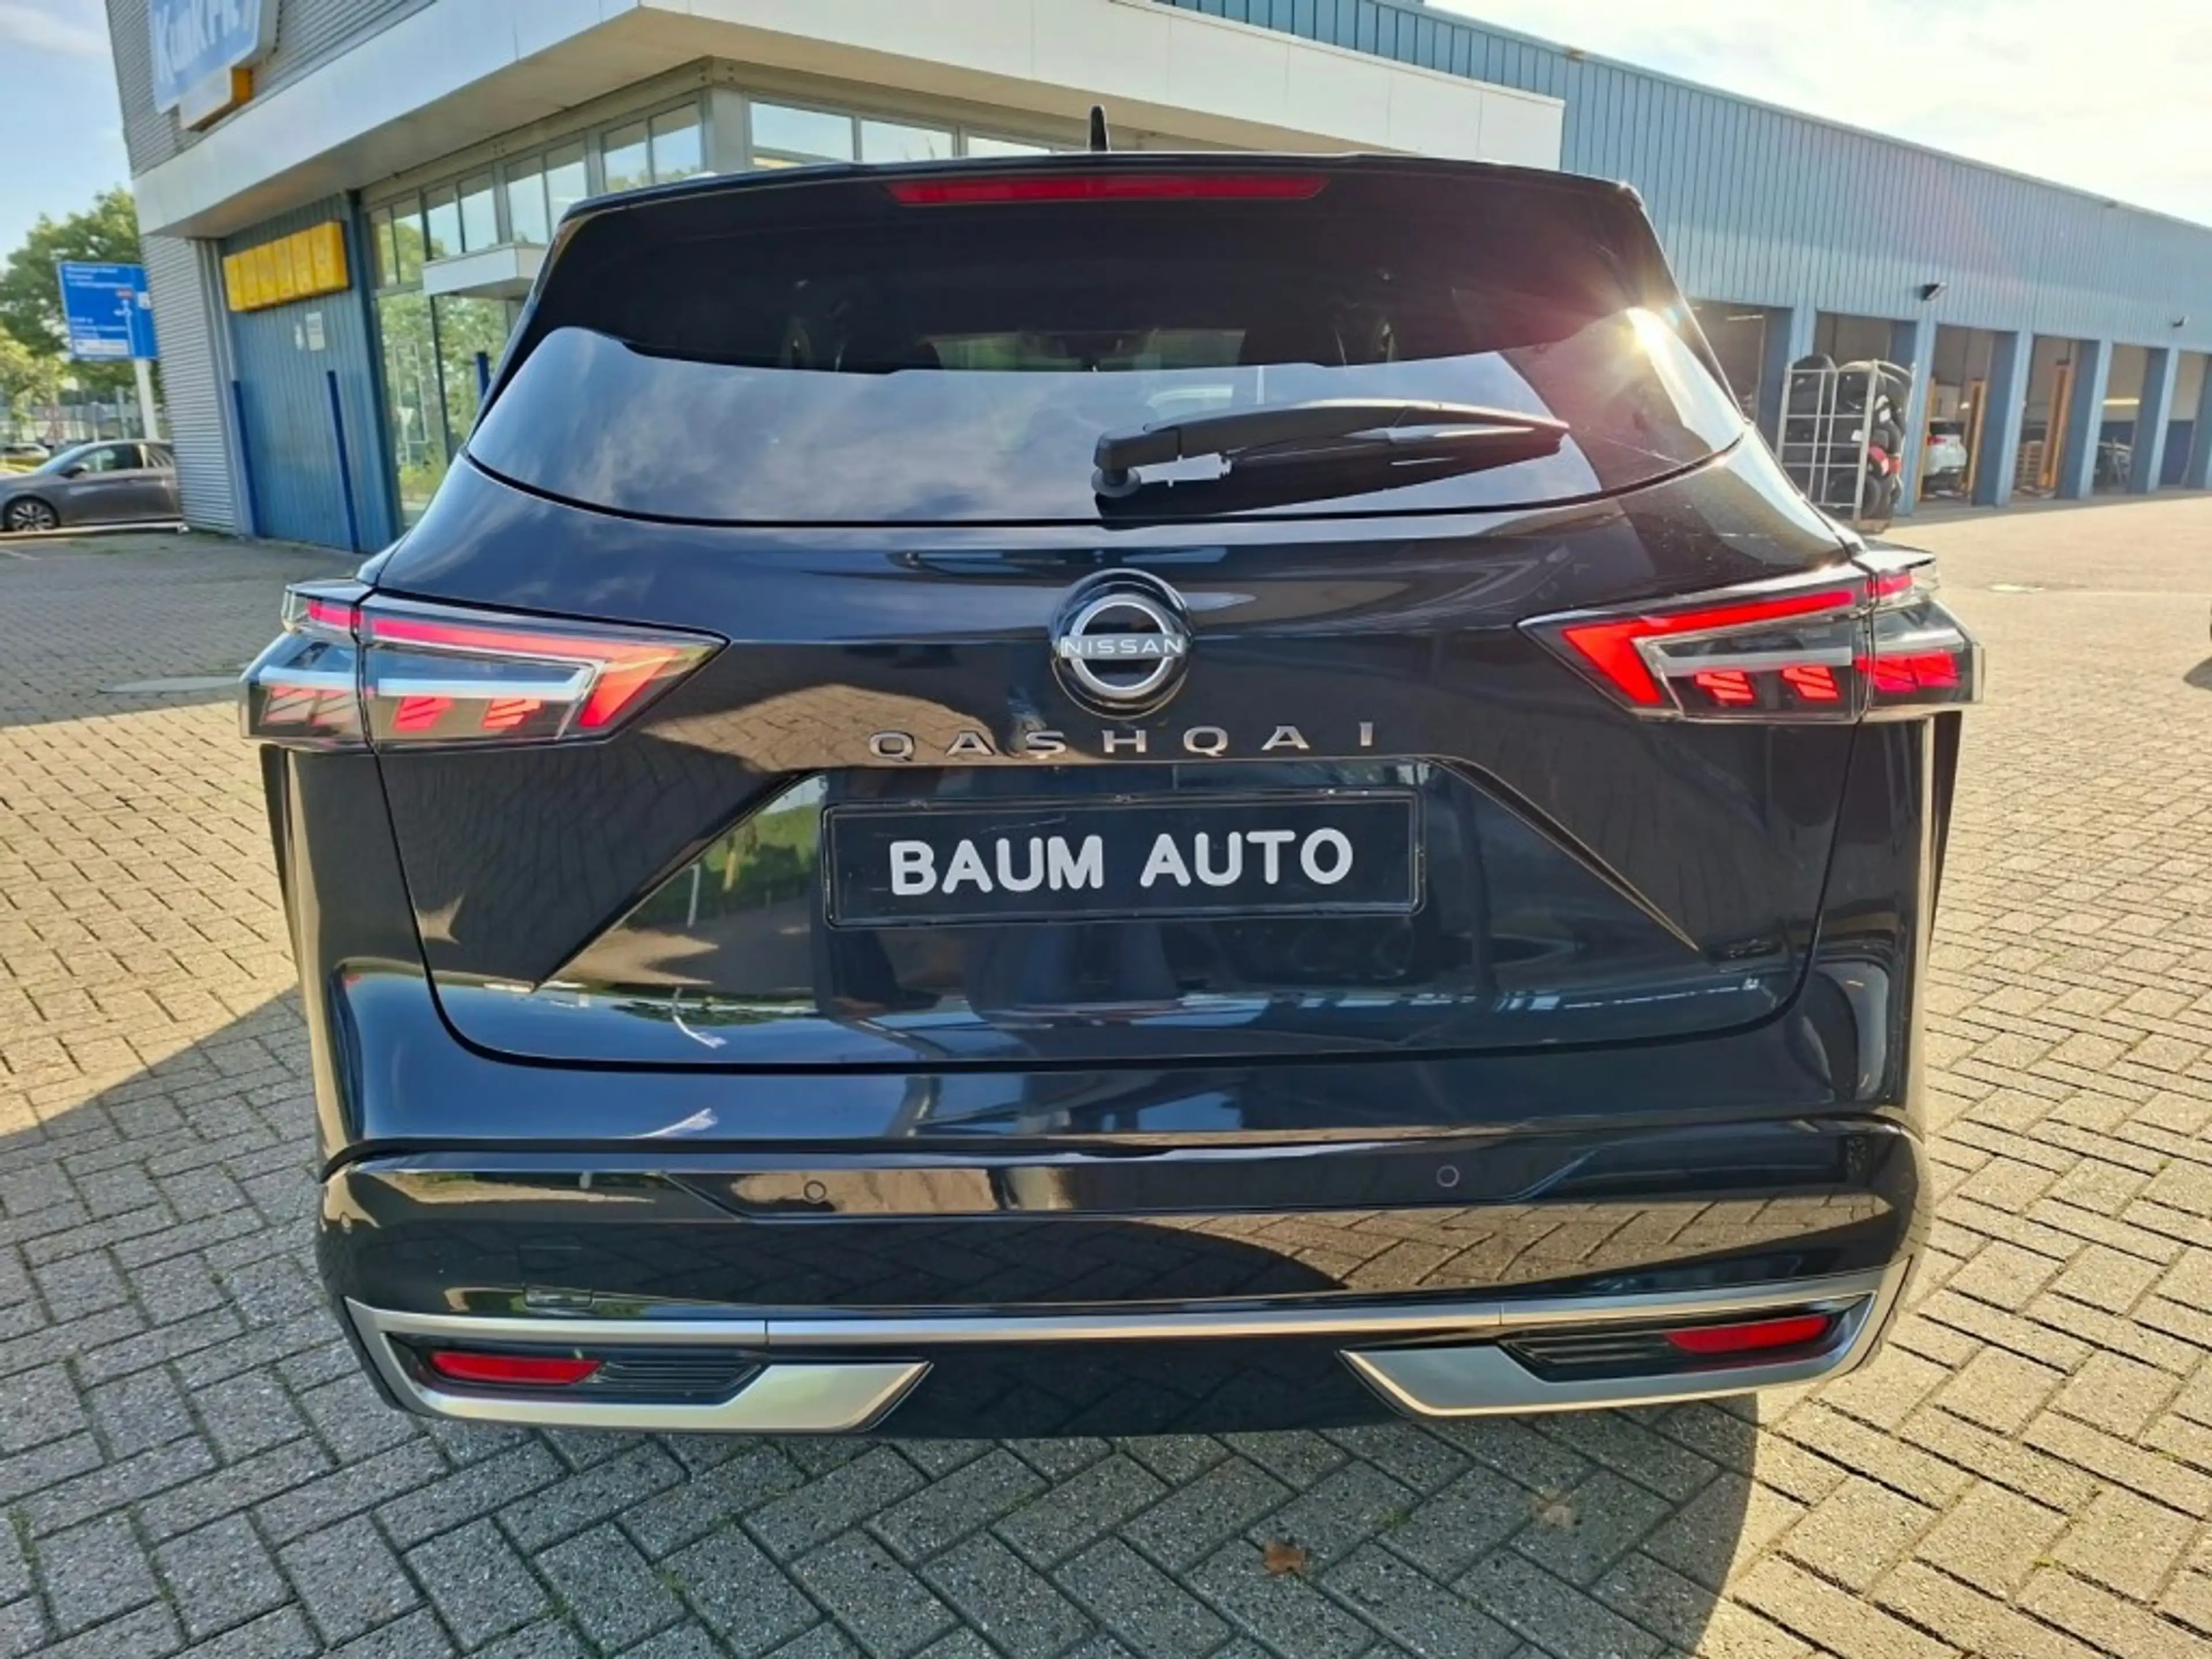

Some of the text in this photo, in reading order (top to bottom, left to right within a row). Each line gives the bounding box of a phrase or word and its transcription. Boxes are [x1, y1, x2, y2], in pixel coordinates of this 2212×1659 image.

[1065, 638, 1182, 654] NISSAN
[869, 722, 1373, 762] QASHQAI
[889, 828, 1354, 896] BAUM AUTO
